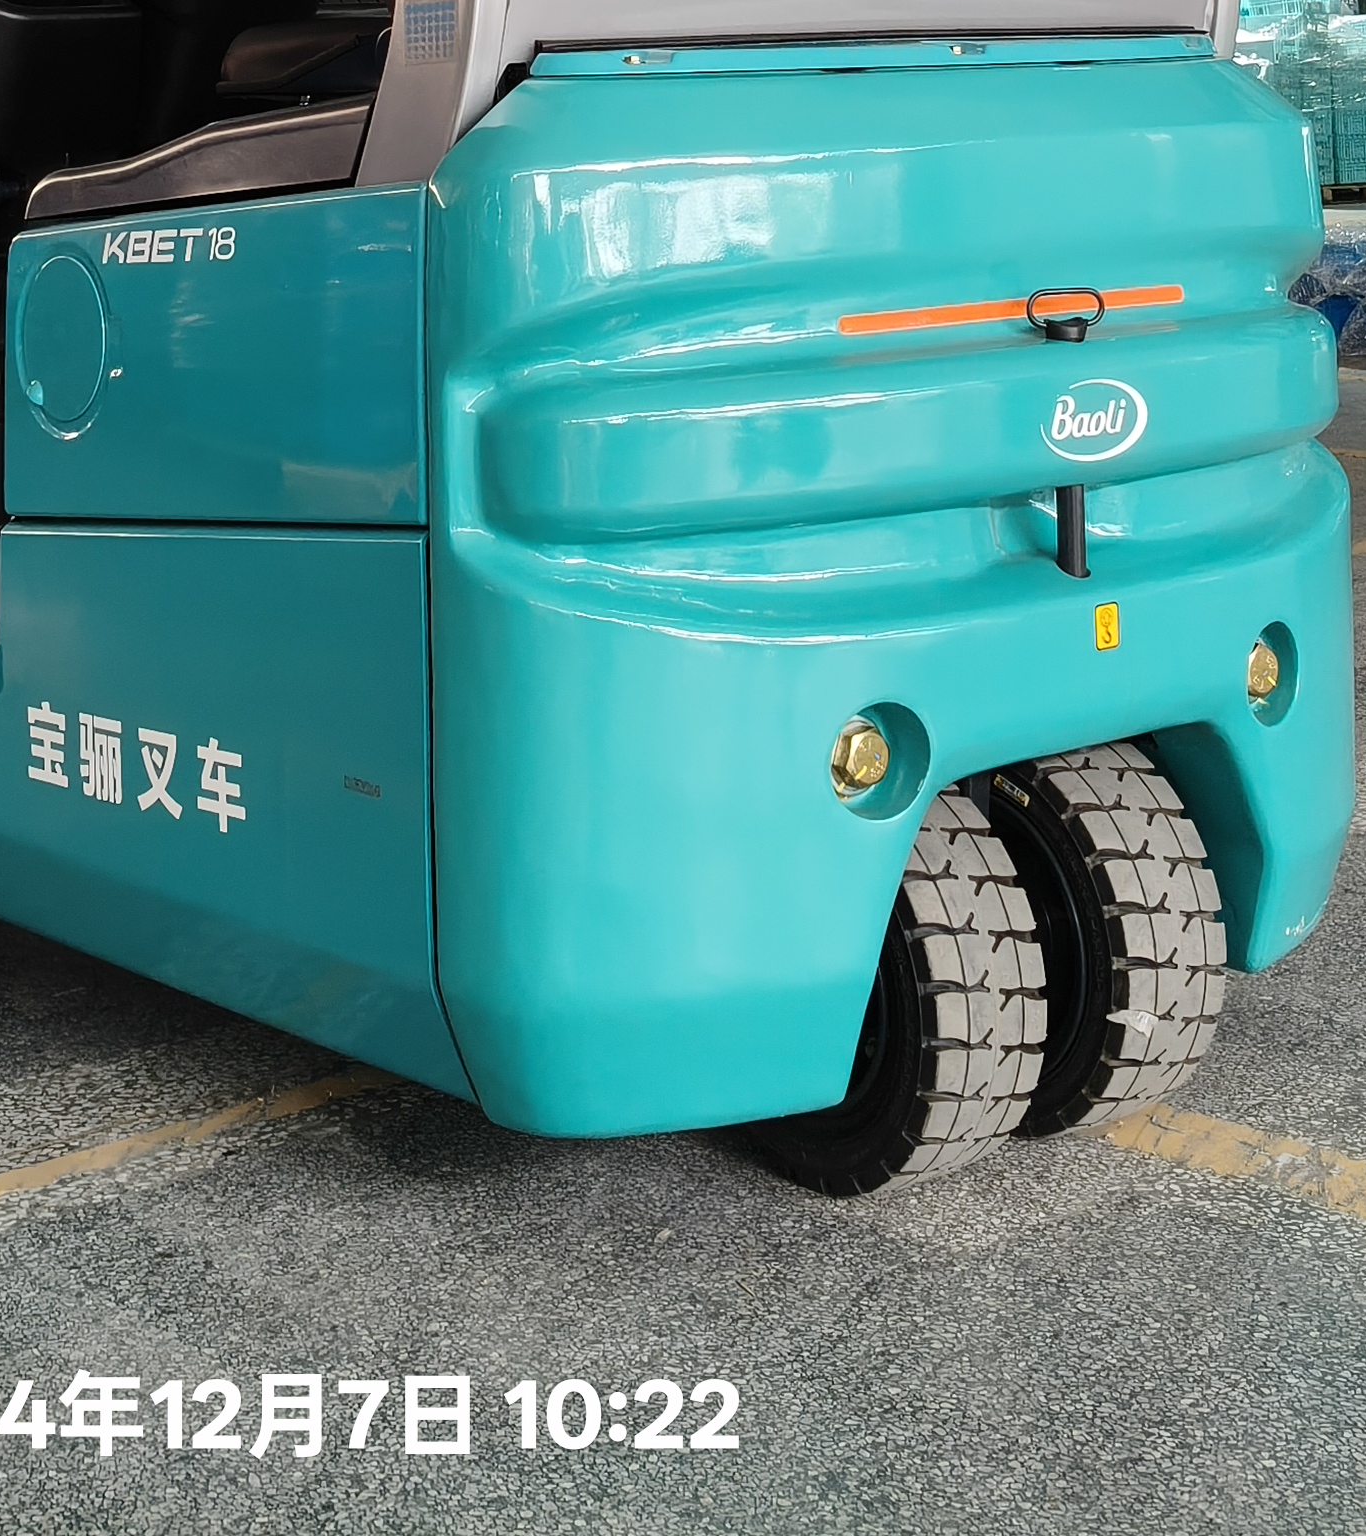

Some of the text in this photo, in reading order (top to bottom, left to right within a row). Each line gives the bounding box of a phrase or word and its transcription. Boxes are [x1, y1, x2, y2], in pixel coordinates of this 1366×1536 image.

[102, 226, 237, 264] KBET 18
[1051, 394, 1127, 441] Baoli
[27, 701, 247, 833] 宝骊叉车
